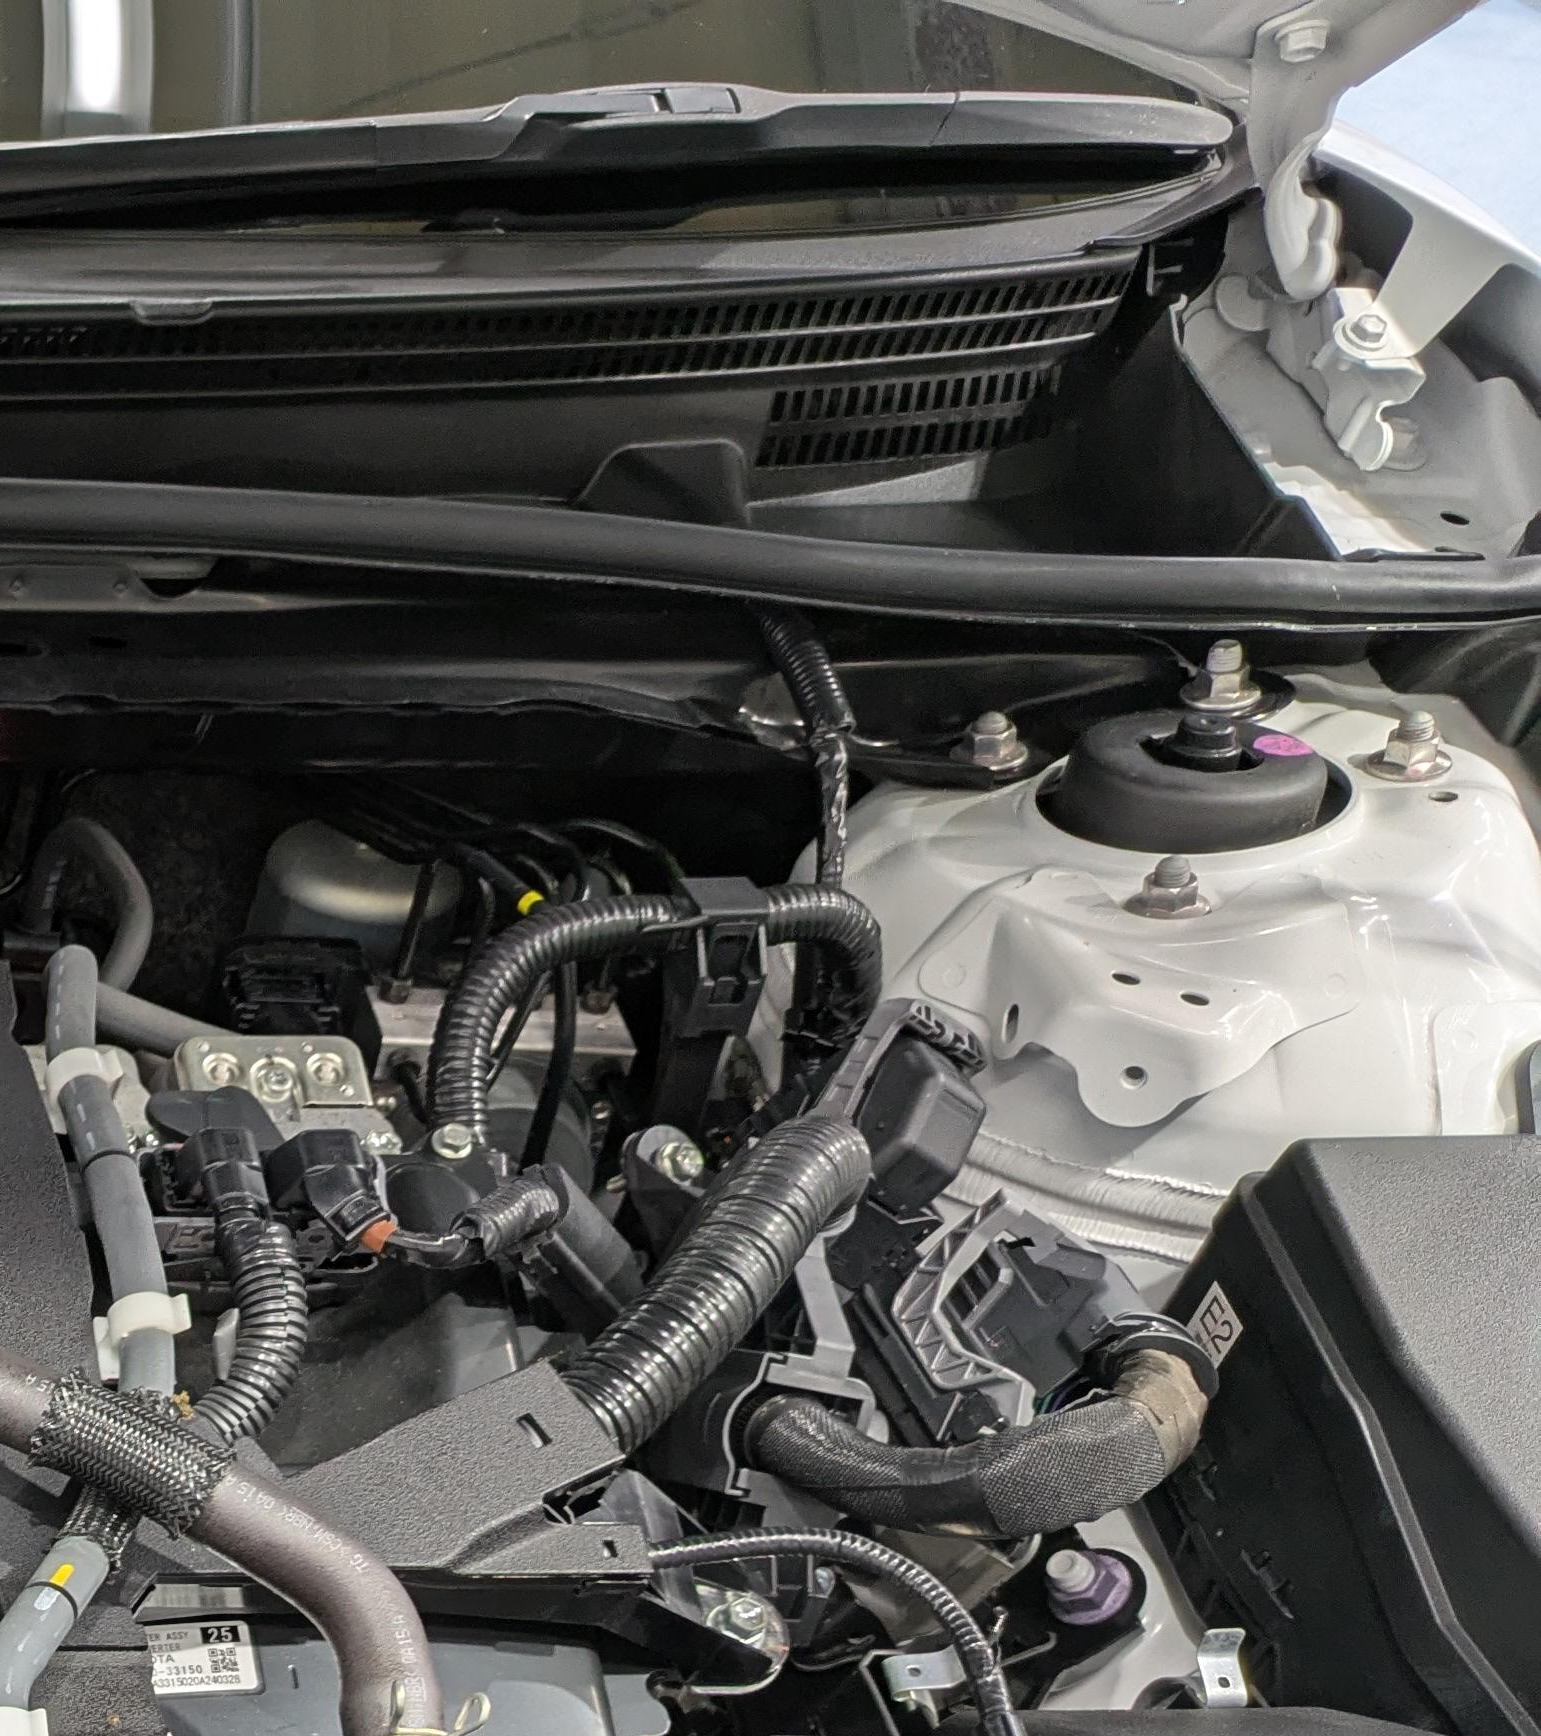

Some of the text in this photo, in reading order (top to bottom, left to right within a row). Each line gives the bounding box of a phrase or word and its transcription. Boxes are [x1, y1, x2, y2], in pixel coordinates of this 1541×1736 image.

[1200, 1296, 1234, 1354] E2
[166, 1631, 189, 1640] ASSY
[207, 1627, 233, 1643] 25
[150, 1643, 181, 1653] ERTER
